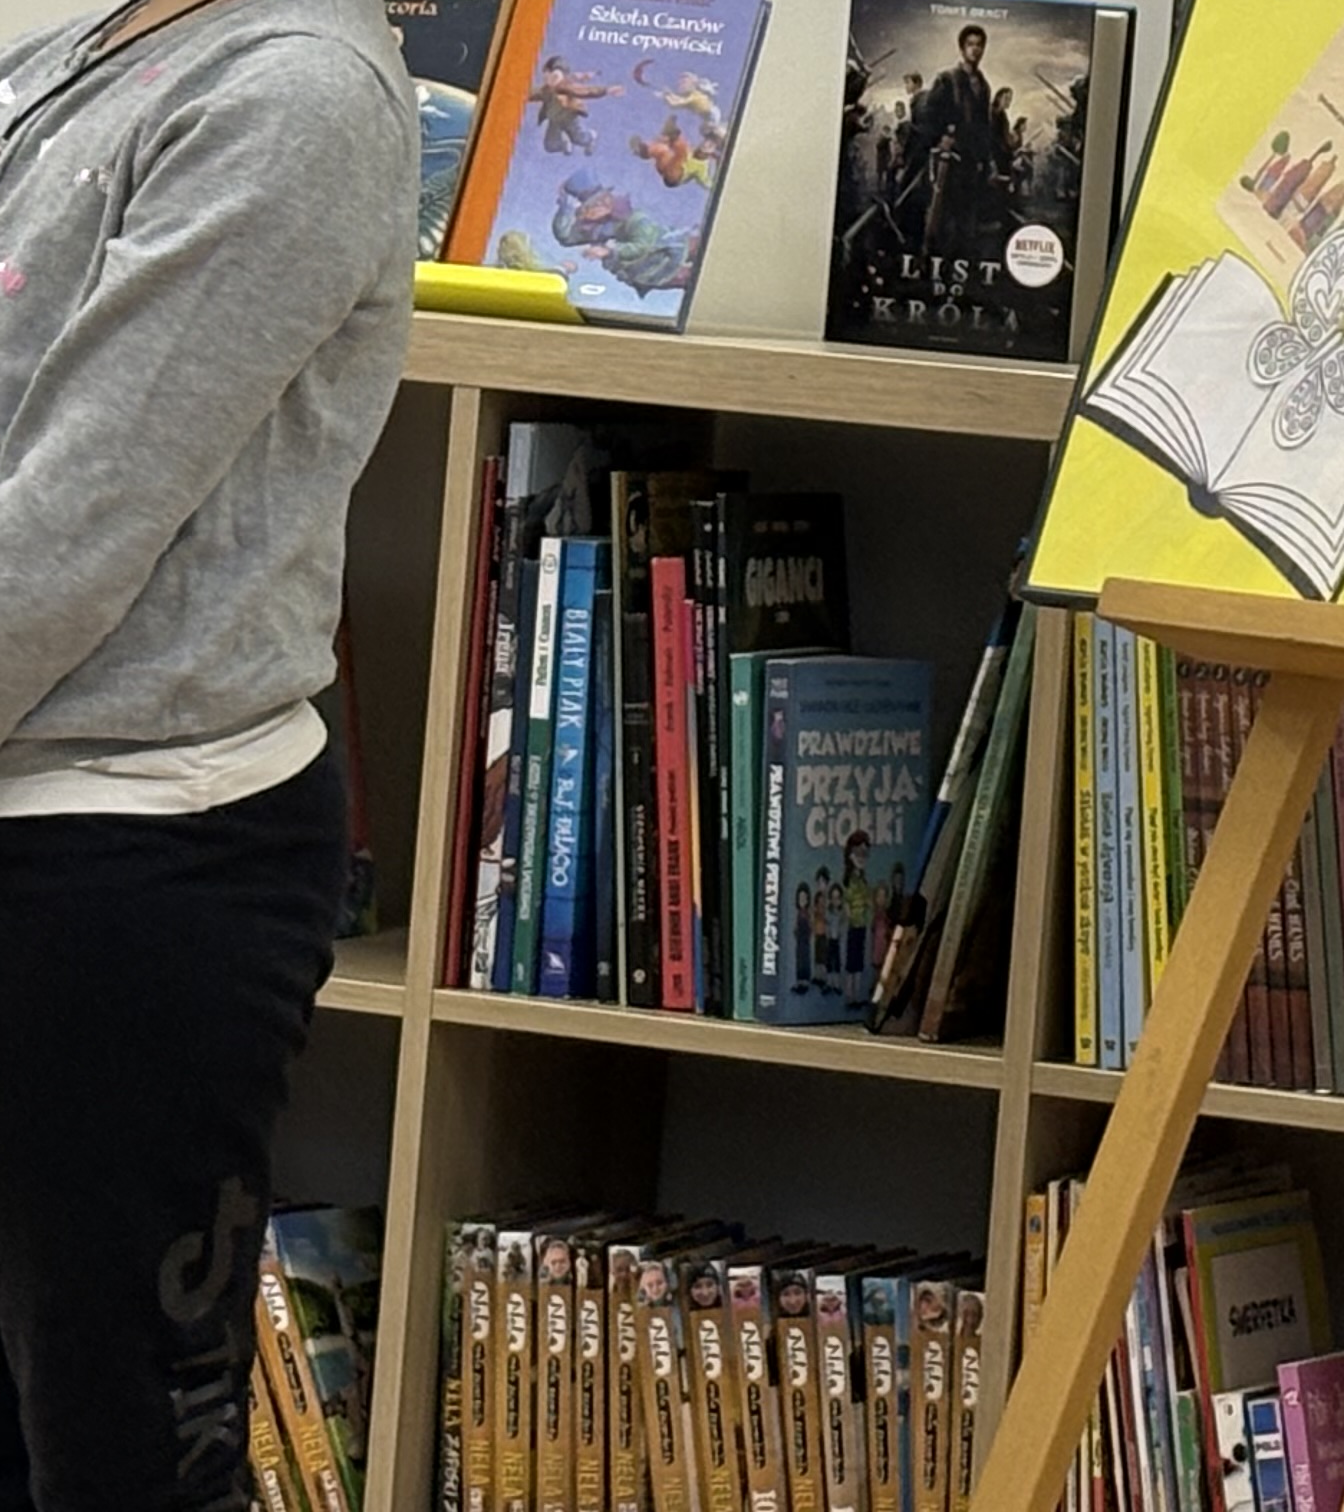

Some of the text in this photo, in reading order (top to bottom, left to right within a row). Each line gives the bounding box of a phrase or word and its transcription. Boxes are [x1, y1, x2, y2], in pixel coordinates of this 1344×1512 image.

[588, 4, 725, 34] Szkoła Czarów
[588, 27, 628, 46] inne
[631, 31, 723, 56] opowieści
[1014, 239, 1056, 255] NETFLIX
[900, 253, 1002, 285] LIST
[798, 729, 922, 758] PRAWDZIWE
[796, 764, 923, 805] PRZYJA-
